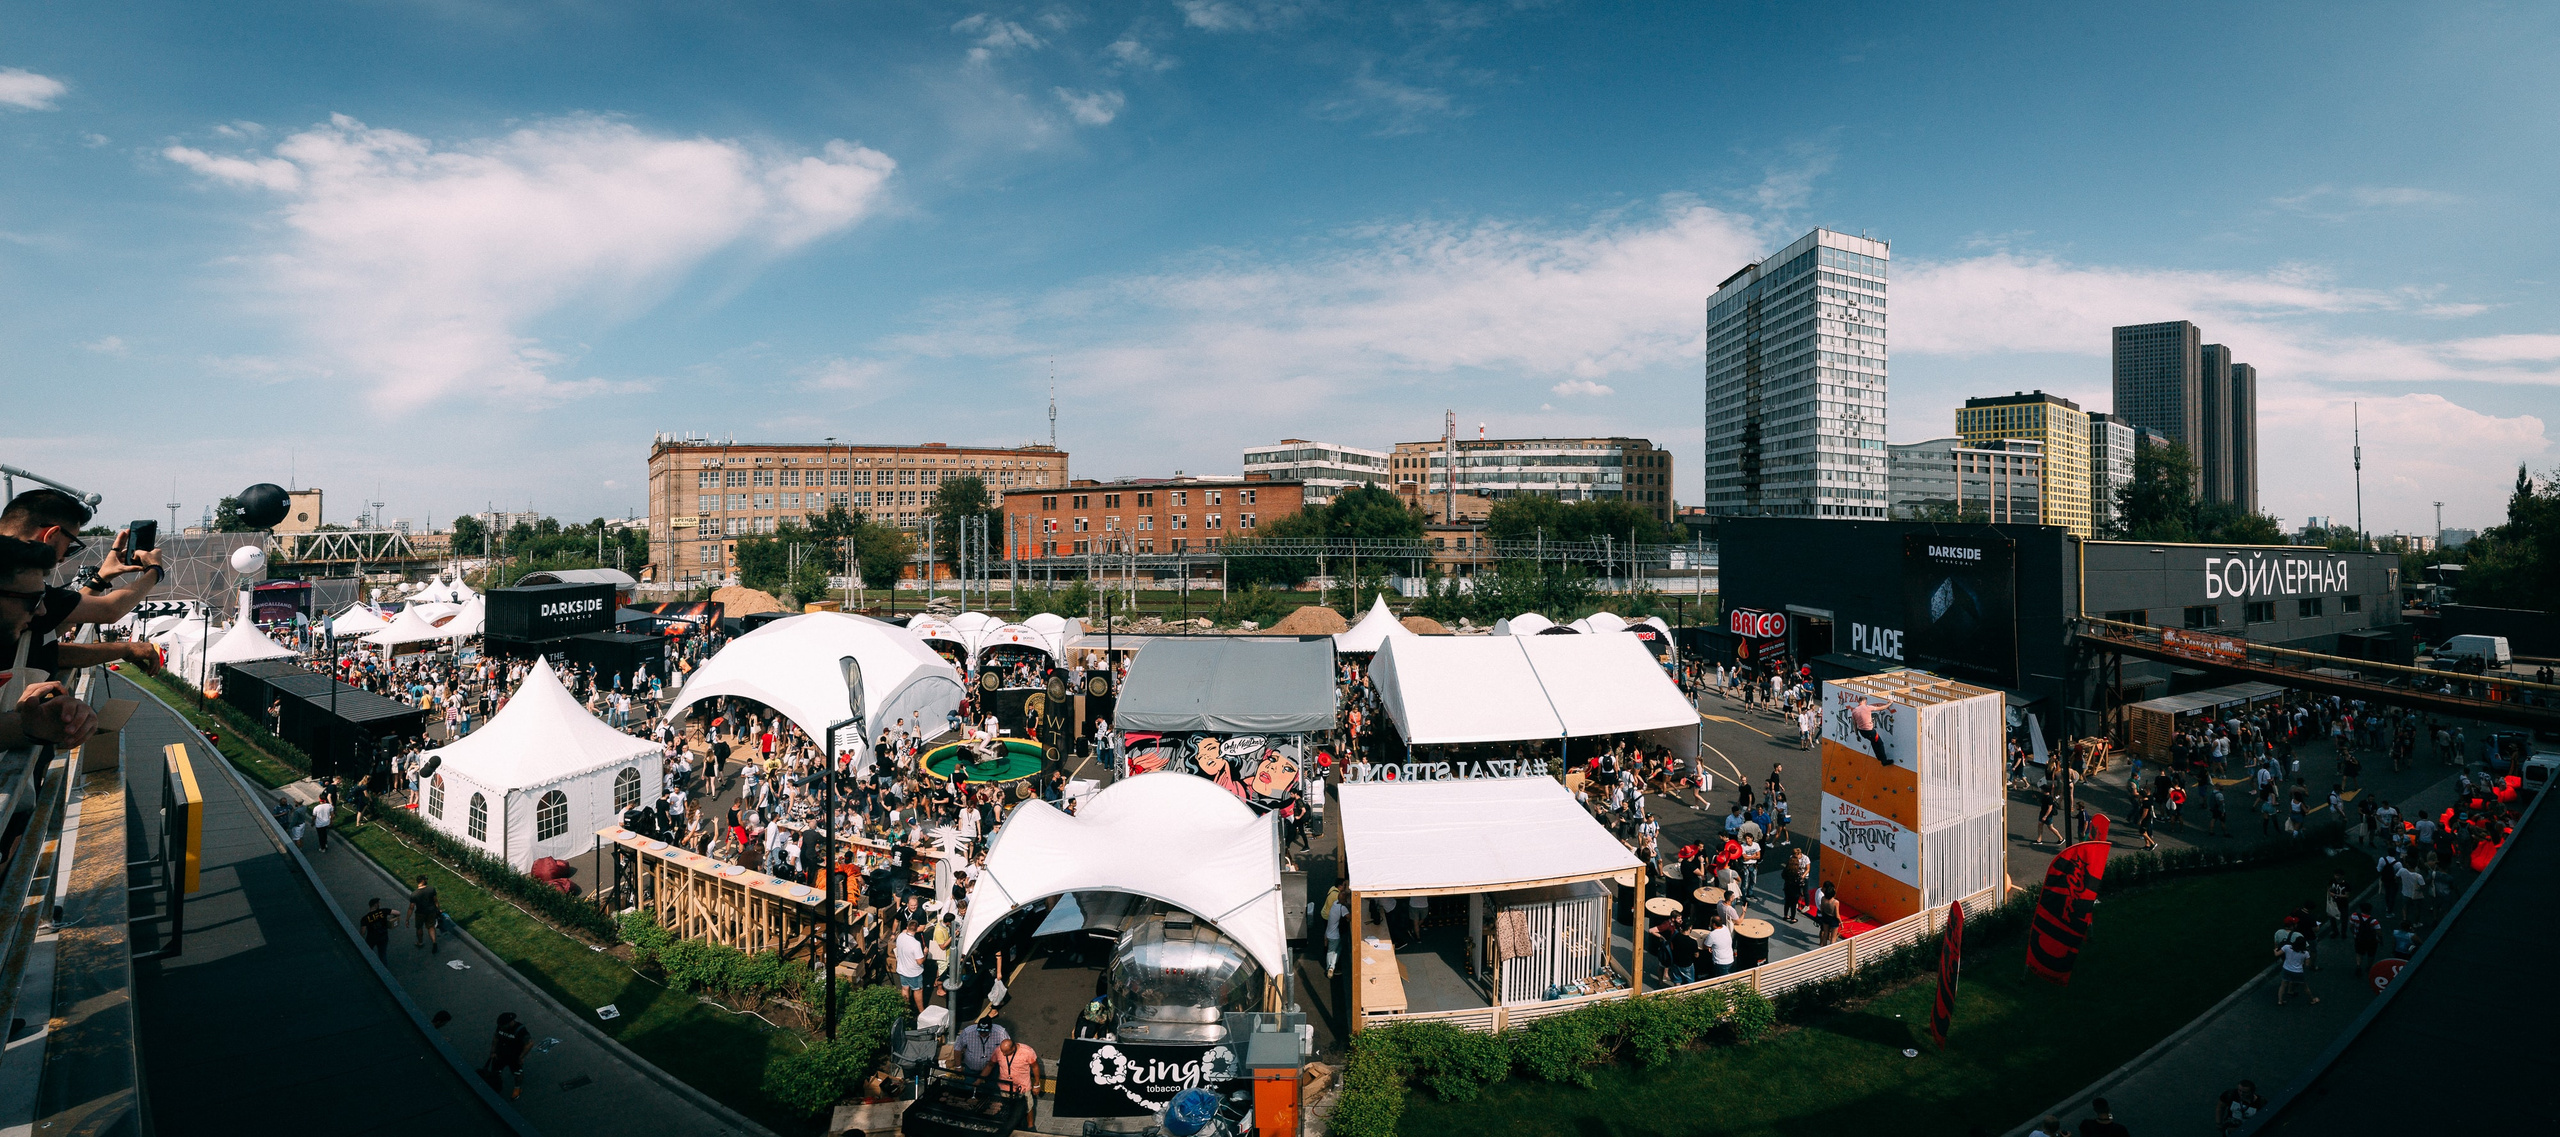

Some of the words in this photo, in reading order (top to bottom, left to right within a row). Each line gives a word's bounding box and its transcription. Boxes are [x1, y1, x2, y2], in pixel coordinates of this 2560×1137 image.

[1928, 545, 1981, 560] DARKSIDE
[2205, 551, 2348, 599] БОЙЛЕРНАЯ
[541, 598, 603, 617] DARKSIDE
[554, 614, 592, 622] TOBACCO
[1731, 609, 1787, 638] BRICO
[1852, 622, 1904, 661] PLACE
[548, 651, 565, 661] THE
[1046, 714, 1065, 762] WTO
[1839, 802, 1867, 819] AFZAL
[1838, 820, 1896, 853] STRONG
[1146, 1084, 1181, 1093] tobacco
